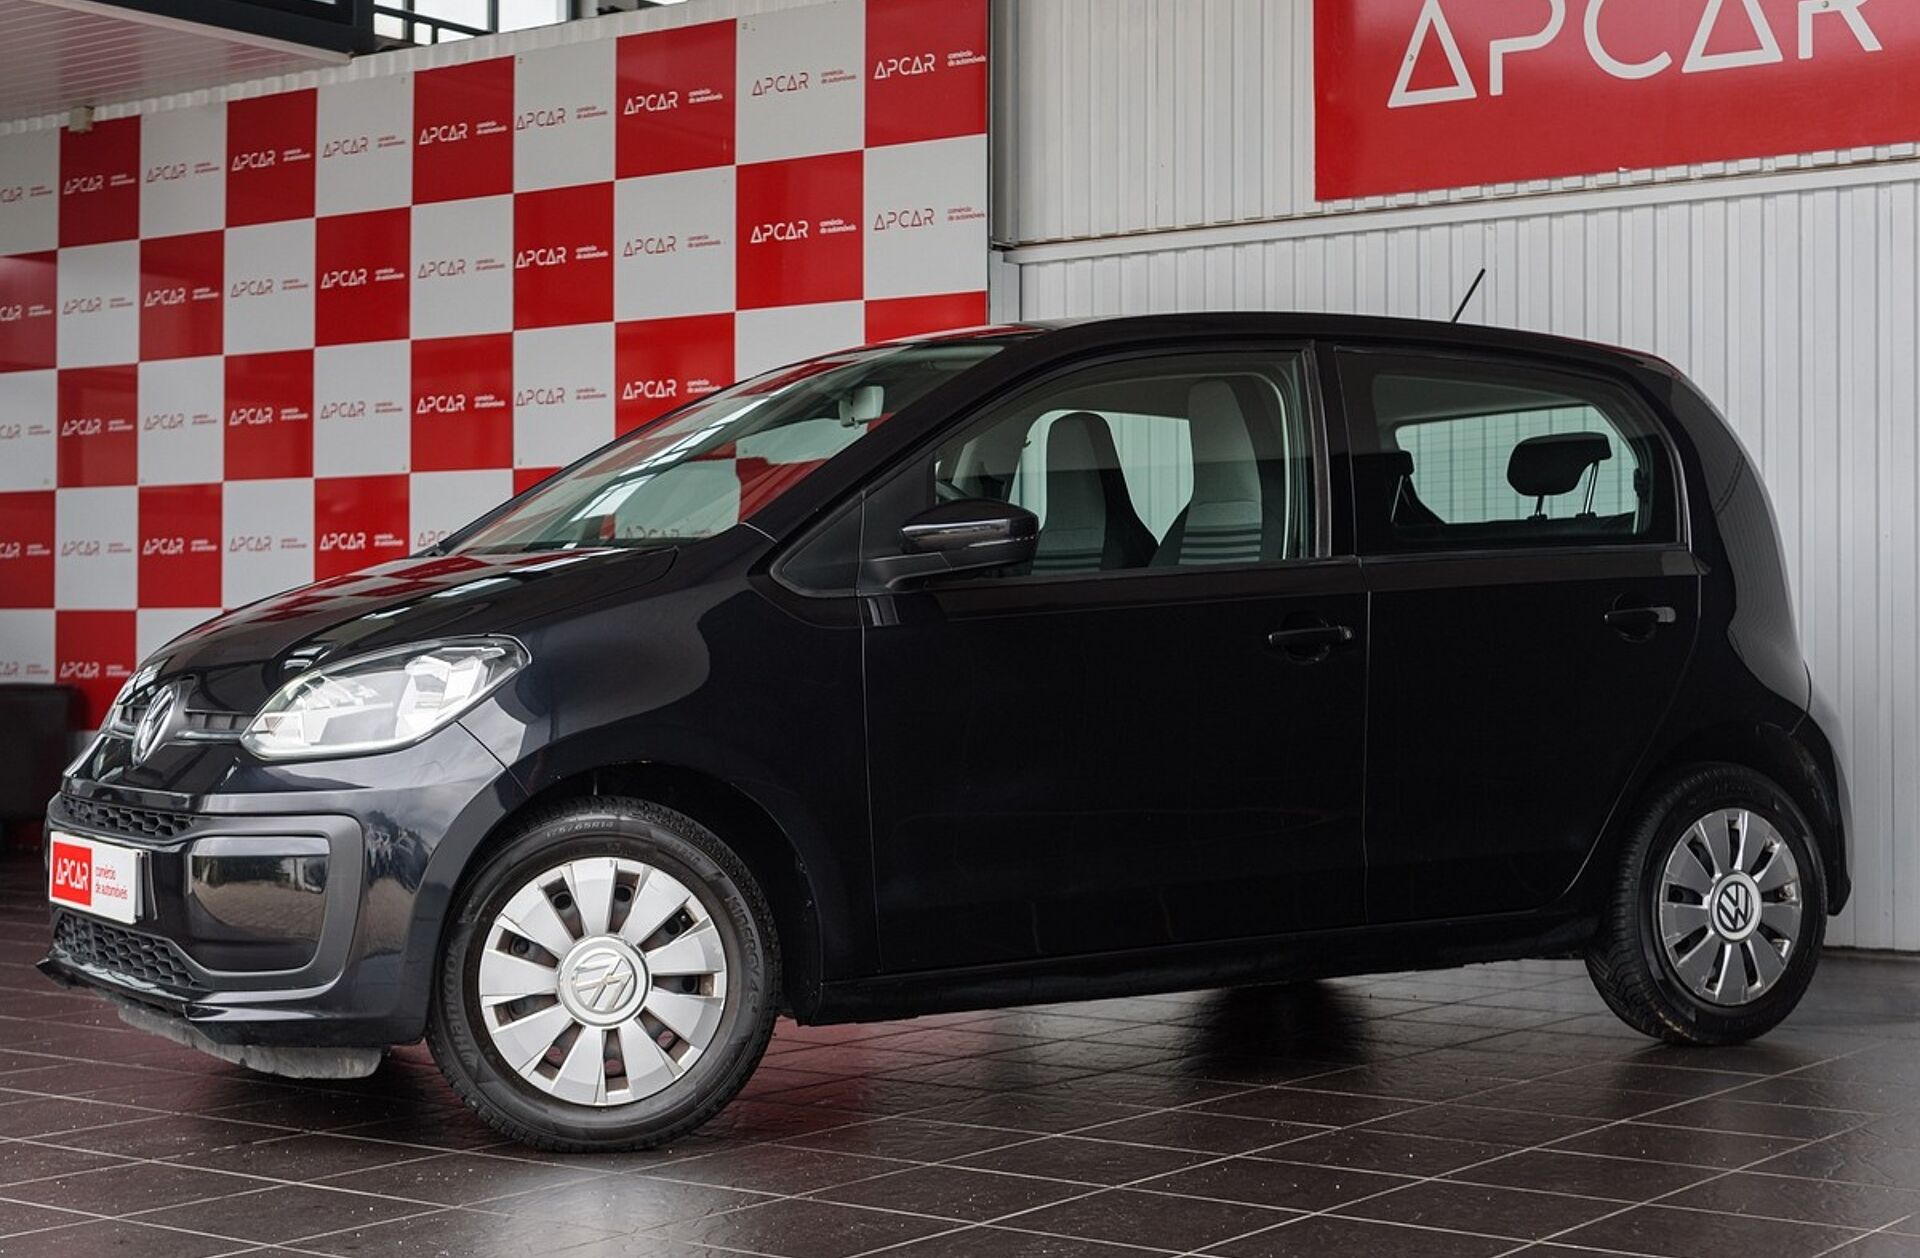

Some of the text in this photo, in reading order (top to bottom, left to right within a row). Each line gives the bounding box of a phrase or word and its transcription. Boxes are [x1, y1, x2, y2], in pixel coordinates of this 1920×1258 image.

[875, 54, 935, 79] APCAR
[753, 72, 808, 96] APCAR
[624, 92, 678, 114] APCAR
[516, 108, 565, 130] APCAR
[419, 123, 467, 145] APCAR
[323, 137, 368, 158] APCAR
[232, 150, 275, 171] APCAR
[146, 164, 187, 183] APCAR
[64, 175, 103, 194] APCAR
[874, 208, 934, 230] APCAR
[751, 221, 808, 243] APCAR
[624, 236, 676, 257] APCAR
[515, 247, 566, 268] APCAR
[321, 269, 367, 288] APCAR
[418, 259, 465, 279] APCAR
[145, 288, 185, 307] APCAR
[231, 279, 273, 297] APCAR
[63, 297, 101, 315] APCAR
[515, 387, 565, 406] APCAR
[623, 380, 676, 399] APCAR
[320, 401, 365, 419] APCAR
[417, 394, 465, 413] APCAR
[144, 413, 184, 430] APCAR
[229, 407, 272, 425] APCAR
[62, 419, 101, 436] APCAR
[62, 541, 99, 556] APCAR
[143, 538, 184, 555] APCAR
[229, 536, 271, 552] APCAR
[320, 533, 365, 550] APCAR
[60, 662, 99, 678] APCAR
[56, 858, 89, 891] APCAR
